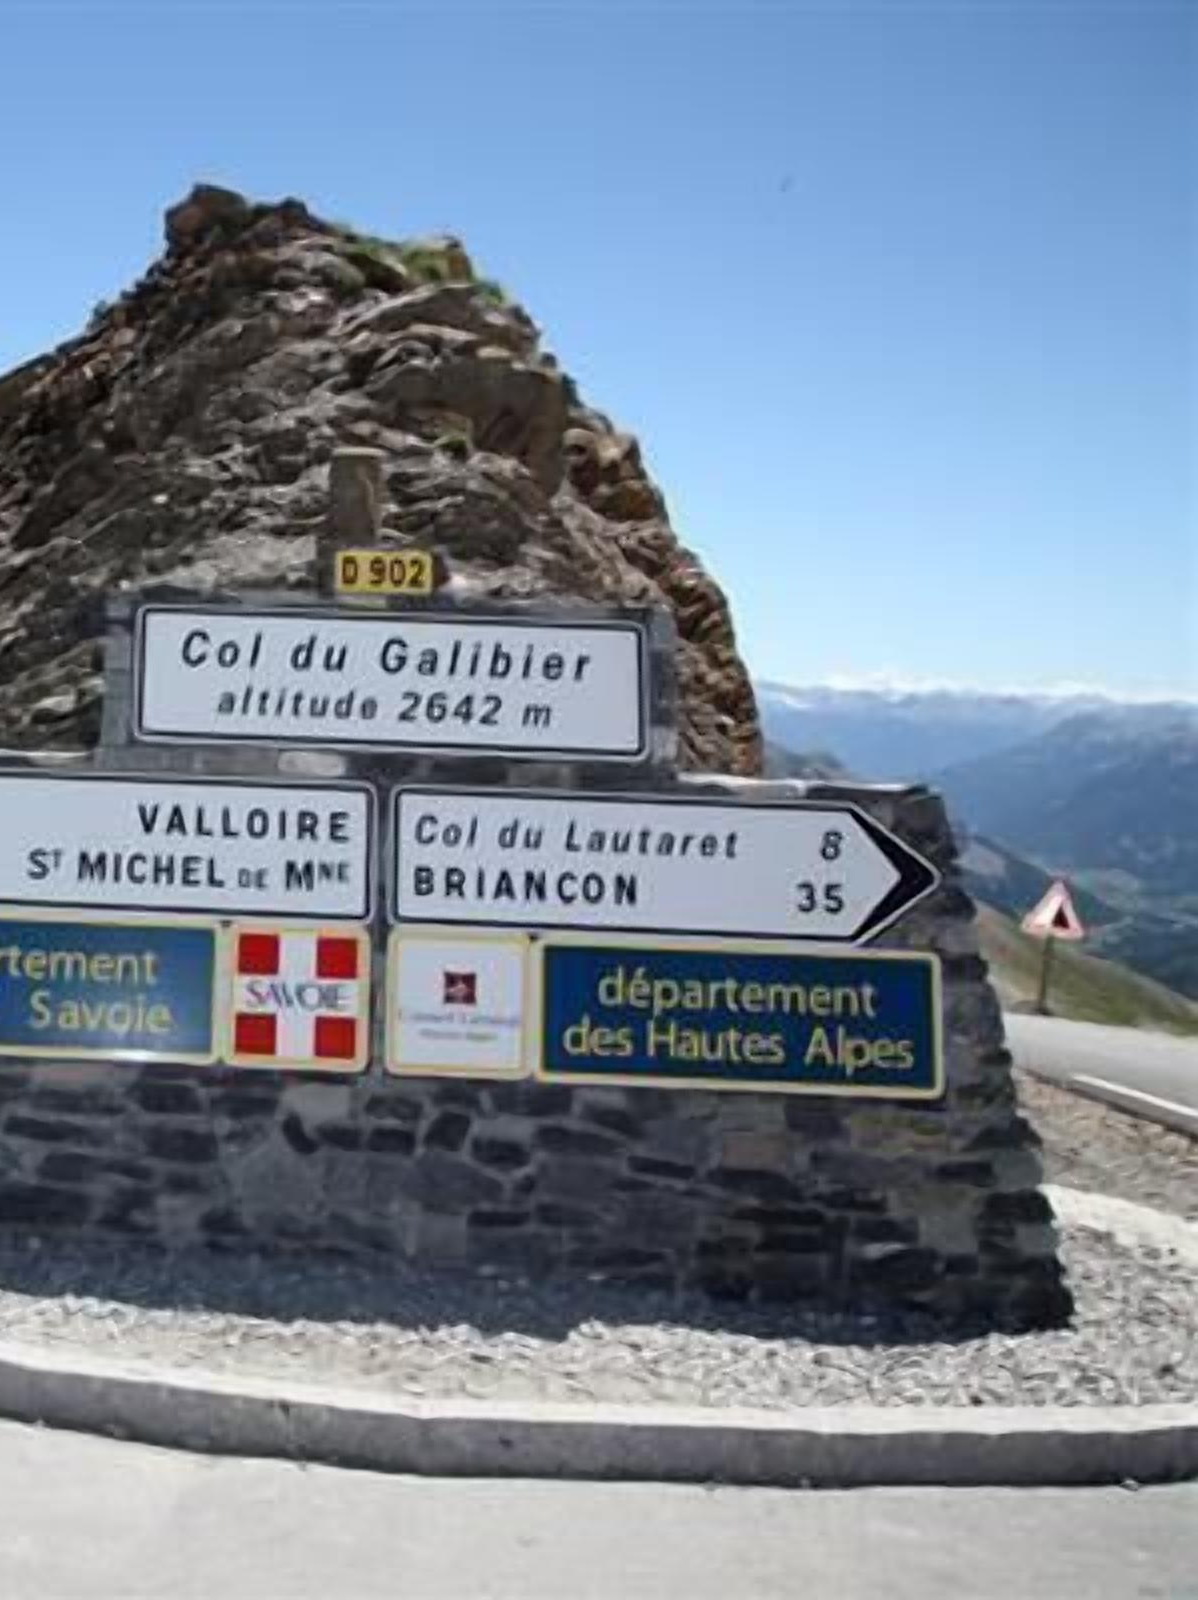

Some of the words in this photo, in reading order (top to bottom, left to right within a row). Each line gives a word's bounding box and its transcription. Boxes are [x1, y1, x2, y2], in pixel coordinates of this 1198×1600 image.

[342, 557, 357, 584] D
[369, 557, 425, 587] 902
[181, 630, 262, 668] Col
[290, 635, 348, 672] du
[379, 638, 592, 682] Galibier
[216, 687, 378, 720] altitude
[398, 692, 502, 727] 2642
[521, 704, 552, 728] m
[137, 804, 351, 842] VALLOIRE
[414, 815, 478, 849] Col
[498, 817, 544, 849] du
[564, 819, 739, 858] Lautaret
[819, 830, 844, 861] 8
[78, 851, 225, 889] MICHEL
[798, 883, 846, 914] 35
[245, 981, 353, 1011] SAVOIE
[599, 967, 877, 1018] département
[31, 992, 174, 1036] Savoie
[563, 1016, 633, 1057] des
[647, 1023, 786, 1065] Hautes
[805, 1028, 915, 1076] Alpes
